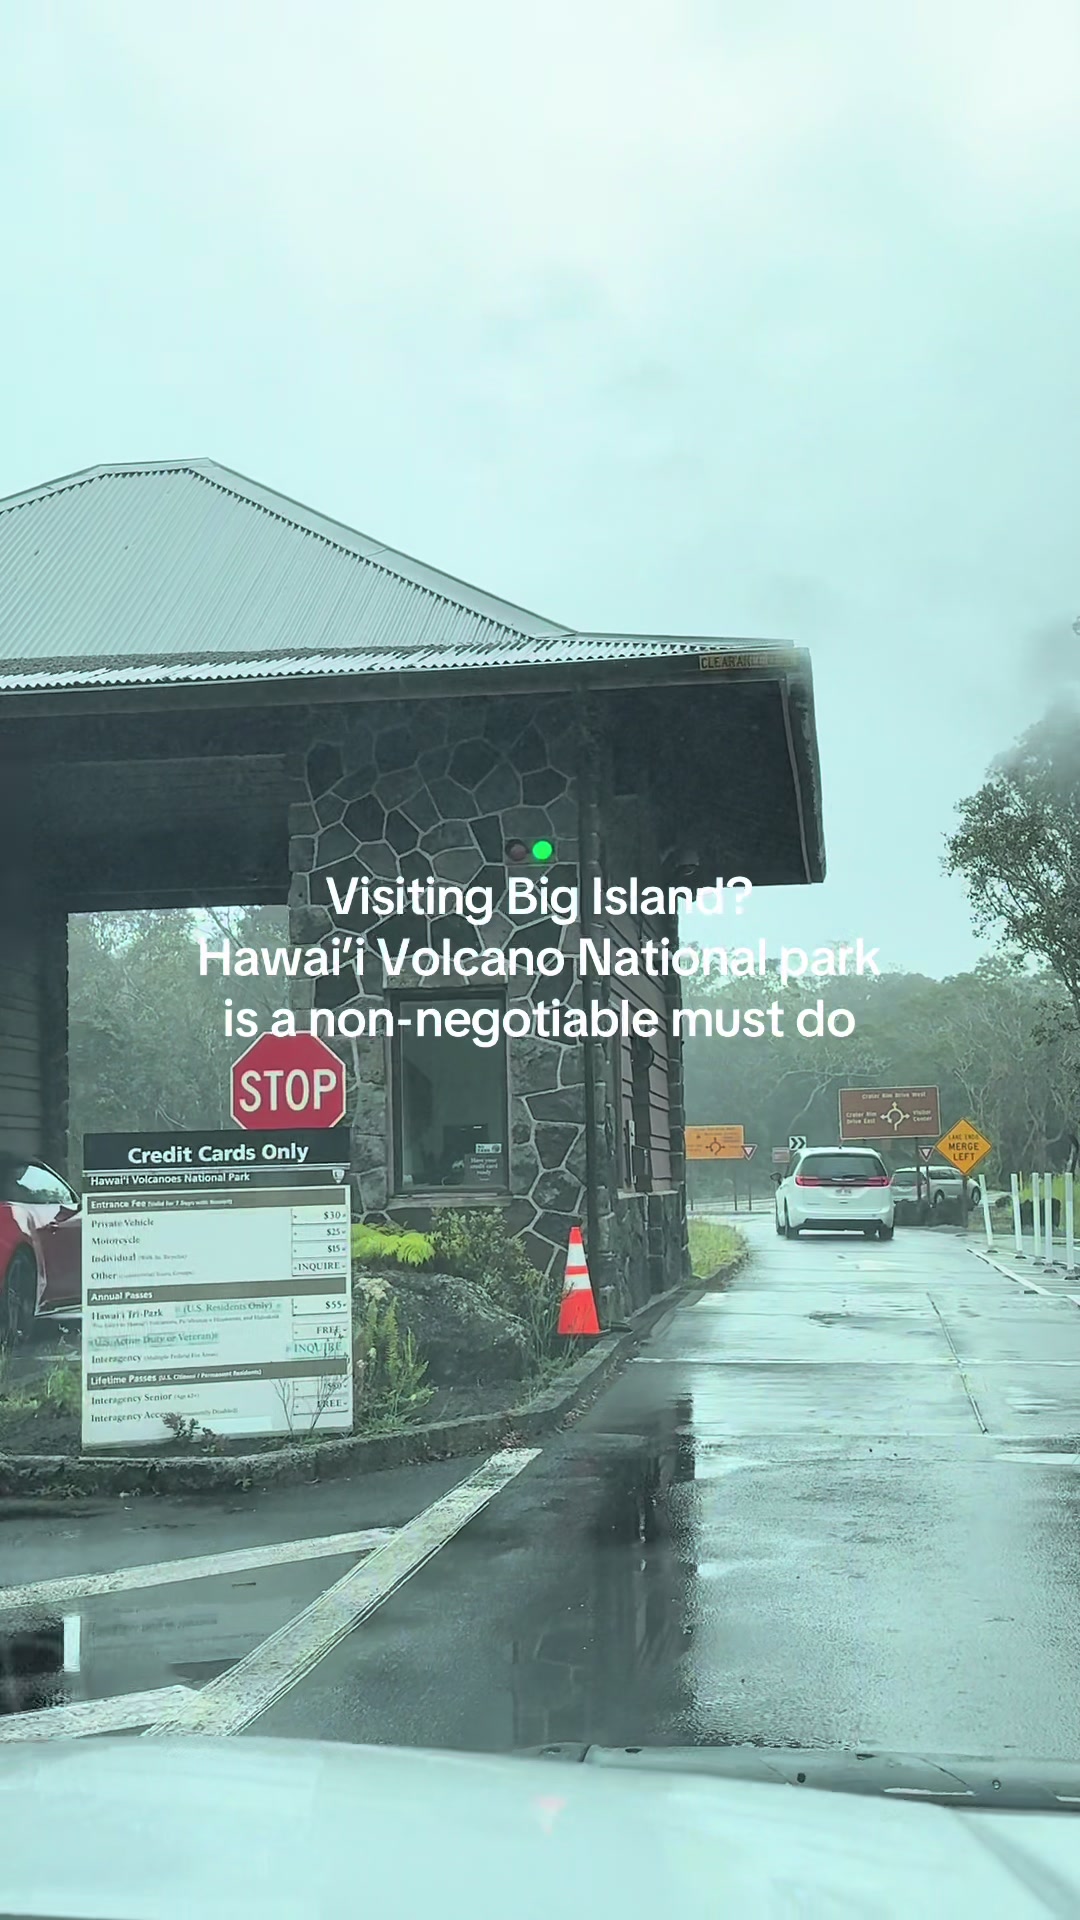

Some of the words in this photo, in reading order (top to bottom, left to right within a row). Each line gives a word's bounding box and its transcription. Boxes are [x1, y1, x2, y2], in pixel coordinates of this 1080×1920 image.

[701, 654, 767, 668] CLEARAN
[239, 1068, 337, 1112] STOP
[948, 1142, 979, 1151] MERGE
[128, 1146, 193, 1164] Credit
[198, 1144, 256, 1162] Cards
[262, 1142, 309, 1162] Only
[953, 1152, 975, 1161] LEFT
[90, 1175, 129, 1186] Hawai'i
[132, 1174, 182, 1185] Volcanoes
[184, 1172, 226, 1183] National
[228, 1172, 251, 1182] Park
[91, 1200, 129, 1209] Entrance
[131, 1199, 147, 1207] Fee
[323, 1211, 341, 1220] $30
[91, 1219, 122, 1229] Private
[124, 1218, 154, 1227] Vehicle
[326, 1228, 341, 1236] $25
[91, 1236, 140, 1246] Motorcycle
[327, 1244, 340, 1253] $15
[91, 1252, 136, 1263] Individual
[298, 1262, 340, 1272] INQUIRE
[91, 1271, 117, 1280] Other
[91, 1291, 123, 1301] Annual
[125, 1291, 153, 1299] Passes
[206, 1302, 246, 1312] Residents
[247, 1301, 273, 1311] Only)
[325, 1300, 342, 1309] $55
[128, 1308, 163, 1319] Tri-Park
[316, 1325, 342, 1334] FREE
[143, 1335, 165, 1345] Duty
[294, 1342, 342, 1353] INQUIRE
[91, 1354, 141, 1364] Interagency
[90, 1375, 127, 1386] Lifetime
[128, 1374, 157, 1383] Passes
[91, 1396, 141, 1405] Interagency
[144, 1393, 173, 1402] Senior
[91, 1412, 141, 1422] Interagency
